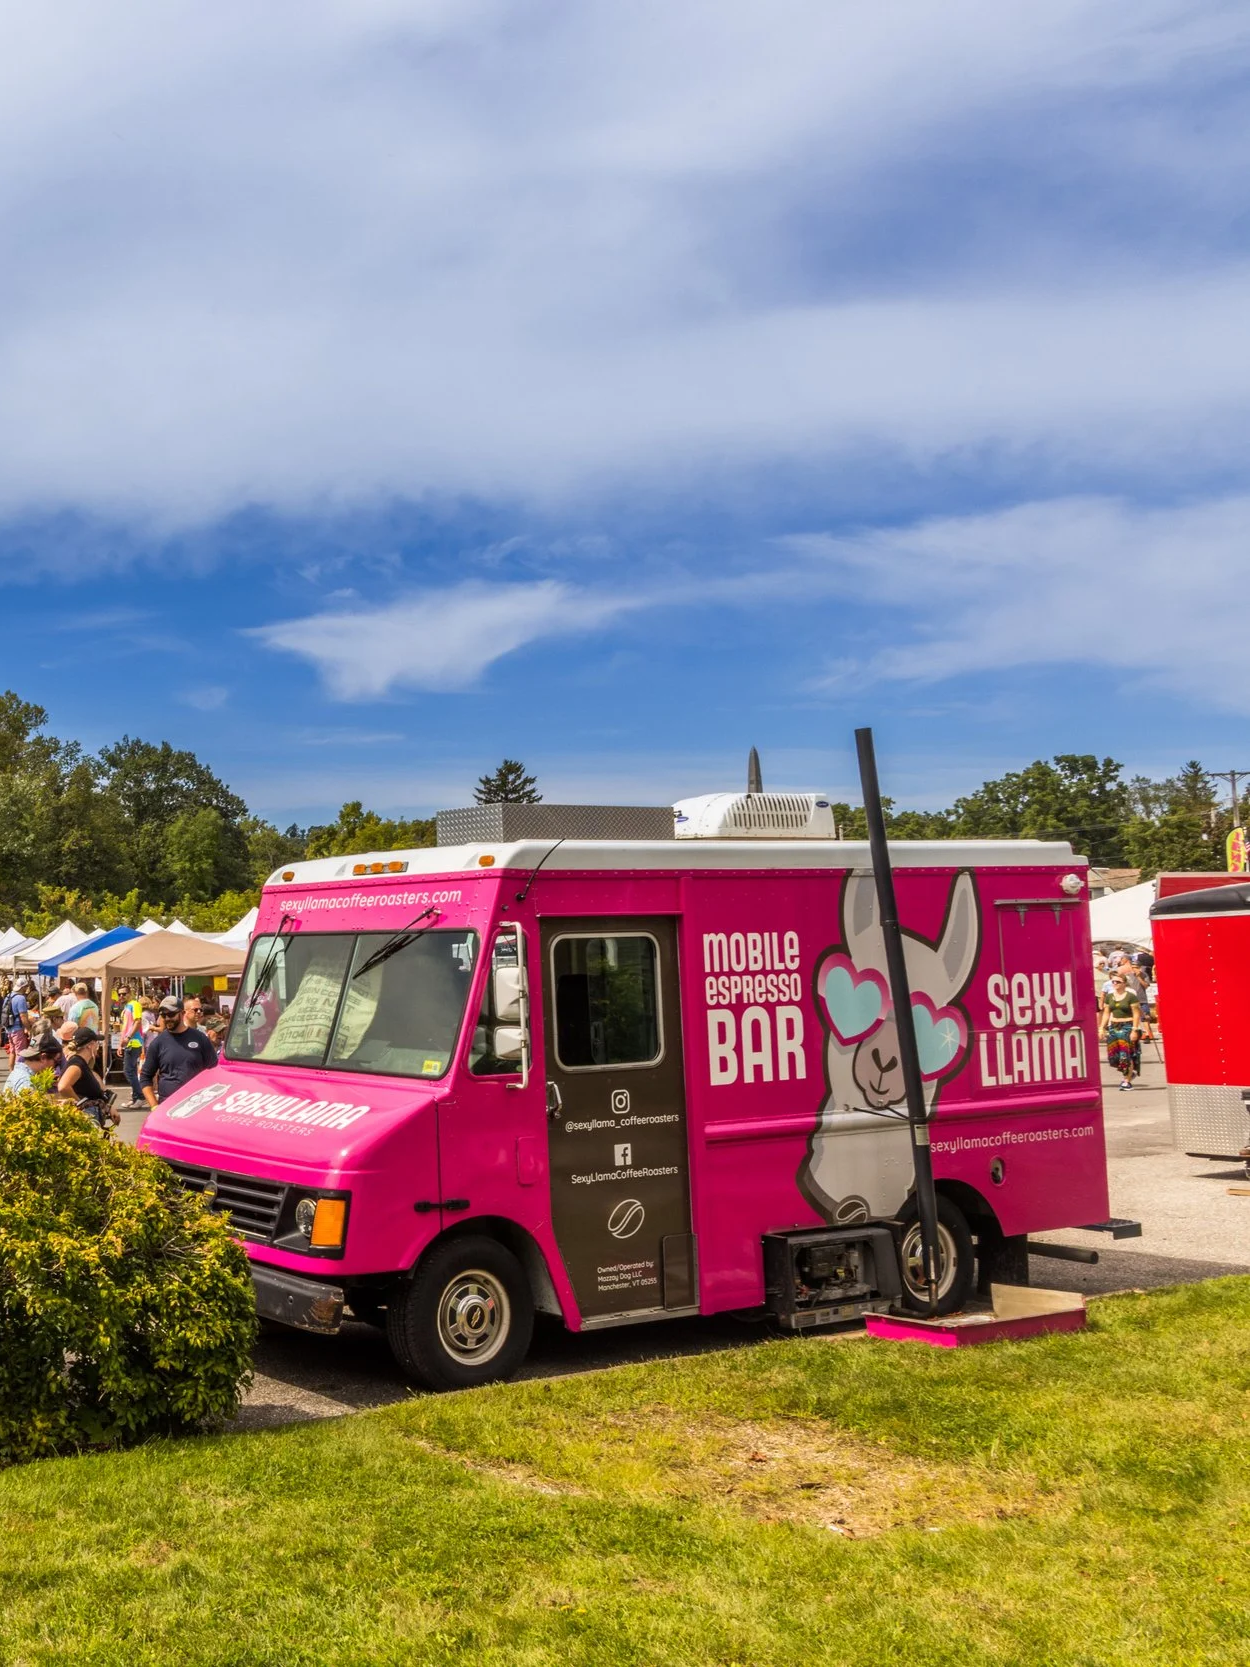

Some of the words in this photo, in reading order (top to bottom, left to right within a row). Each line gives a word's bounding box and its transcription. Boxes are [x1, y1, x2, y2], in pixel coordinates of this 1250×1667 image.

[280, 889, 462, 913] sexyllamacoffeeroasters.com
[706, 1005, 807, 1086] BAR
[979, 1026, 1088, 1087] LLAMA
[215, 1114, 252, 1127] COFFEE
[256, 1120, 315, 1137] ROASTERS
[565, 1114, 679, 1132] @sexyllama_coffeeroasters
[930, 1125, 1094, 1154] sexyllamacoffeeroasters.com
[571, 1166, 679, 1184] SexyLlamaCoffeeRoasters
[597, 1261, 645, 1274] Owned/Operated
[619, 1272, 631, 1280] Dog
[632, 1270, 642, 1278] LLC
[632, 1279, 640, 1287] VT
[640, 1277, 658, 1286] 05255
